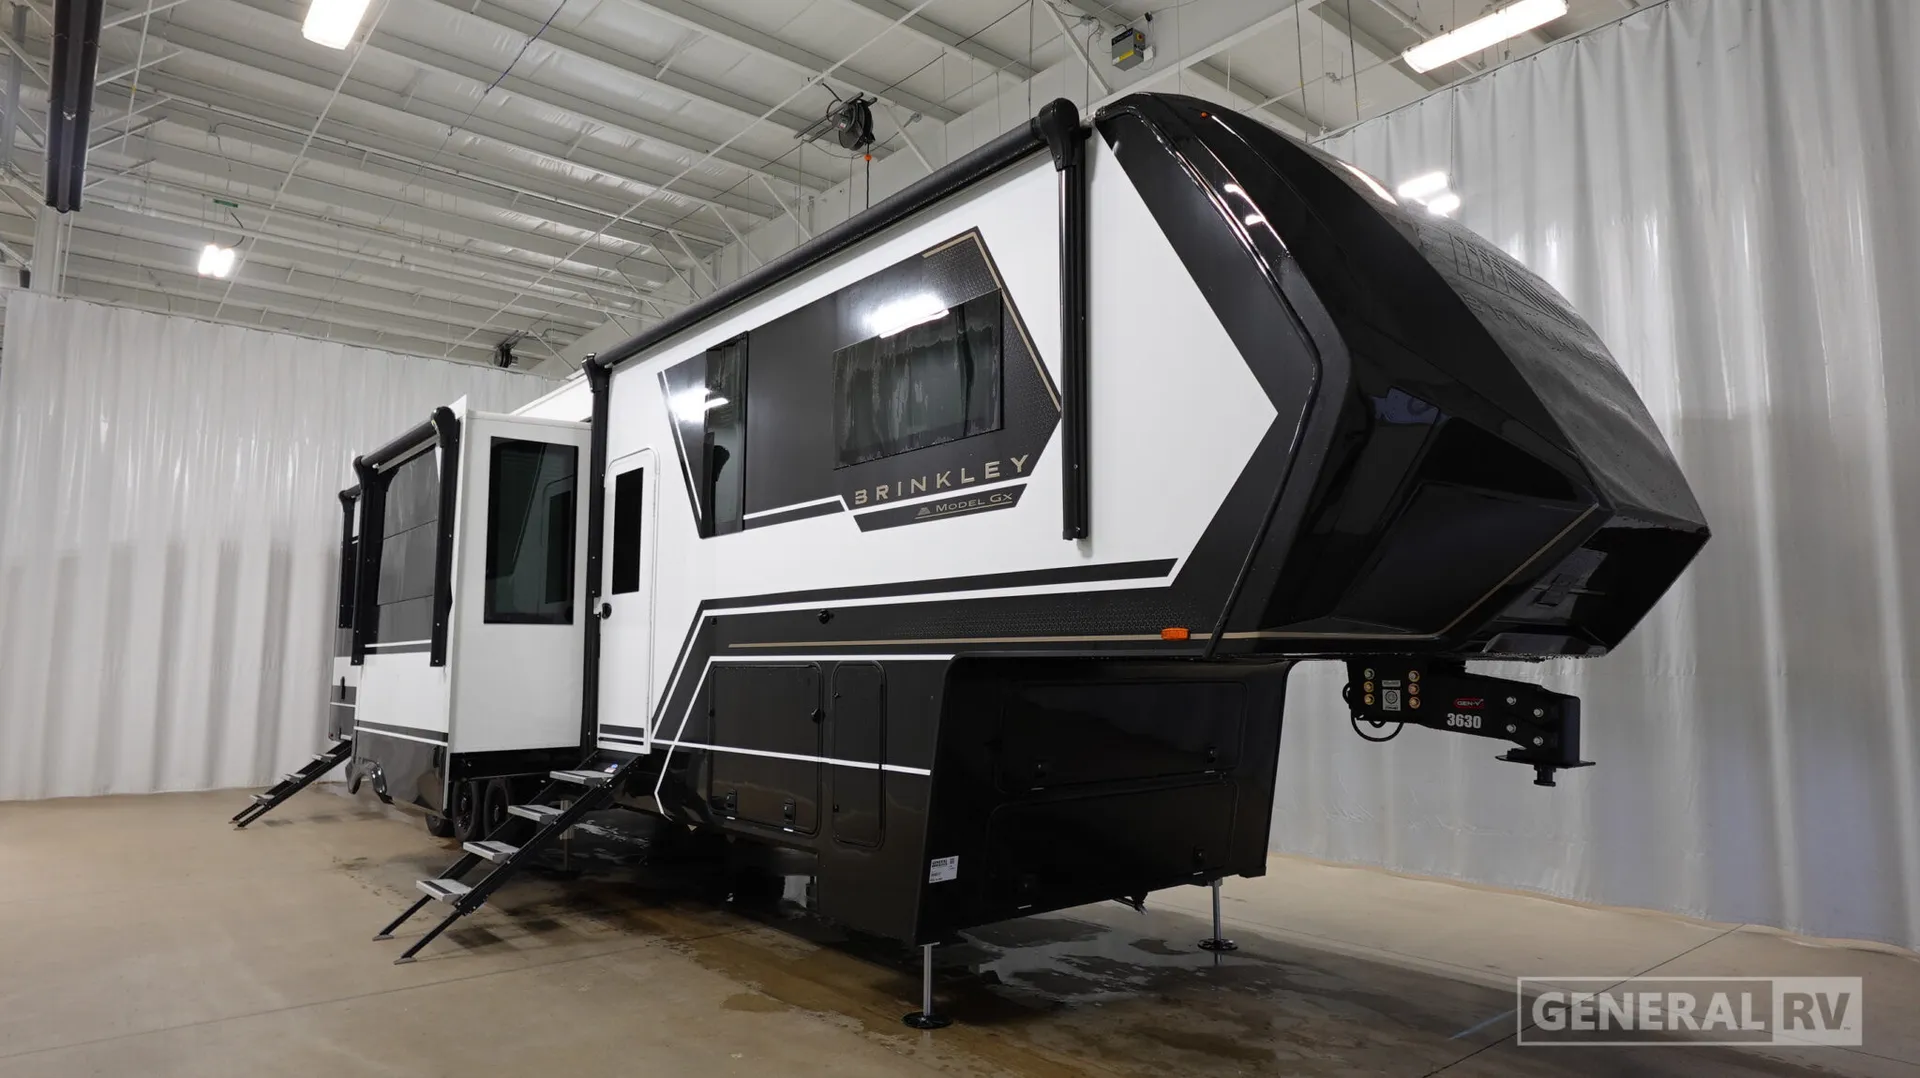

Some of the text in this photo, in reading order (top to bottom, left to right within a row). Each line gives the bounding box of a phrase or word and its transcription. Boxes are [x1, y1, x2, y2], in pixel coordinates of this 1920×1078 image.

[855, 454, 1029, 505] BRINKLEY
[936, 493, 1013, 512] MODEL GX
[1446, 712, 1482, 729] 3630
